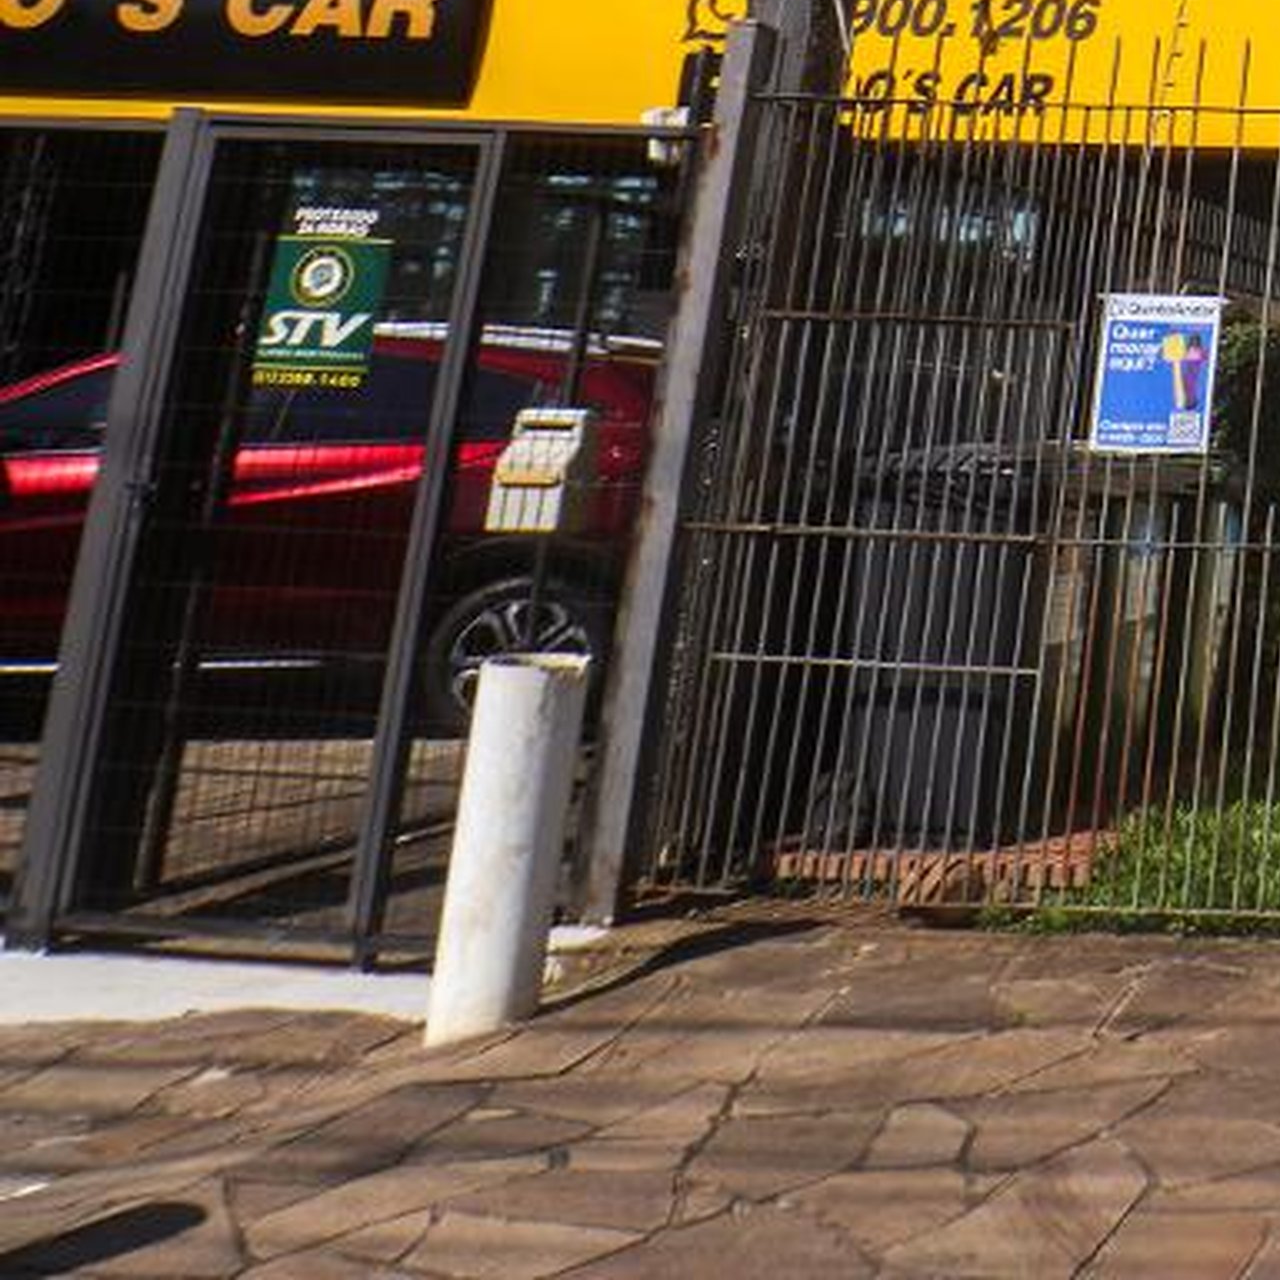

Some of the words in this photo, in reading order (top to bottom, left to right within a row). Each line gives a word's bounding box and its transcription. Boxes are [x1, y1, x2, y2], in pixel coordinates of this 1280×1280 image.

[952, 72, 1054, 116] CAR
[258, 310, 373, 347] STV
[1113, 323, 1157, 341] Quer
[1110, 342, 1161, 355] morar
